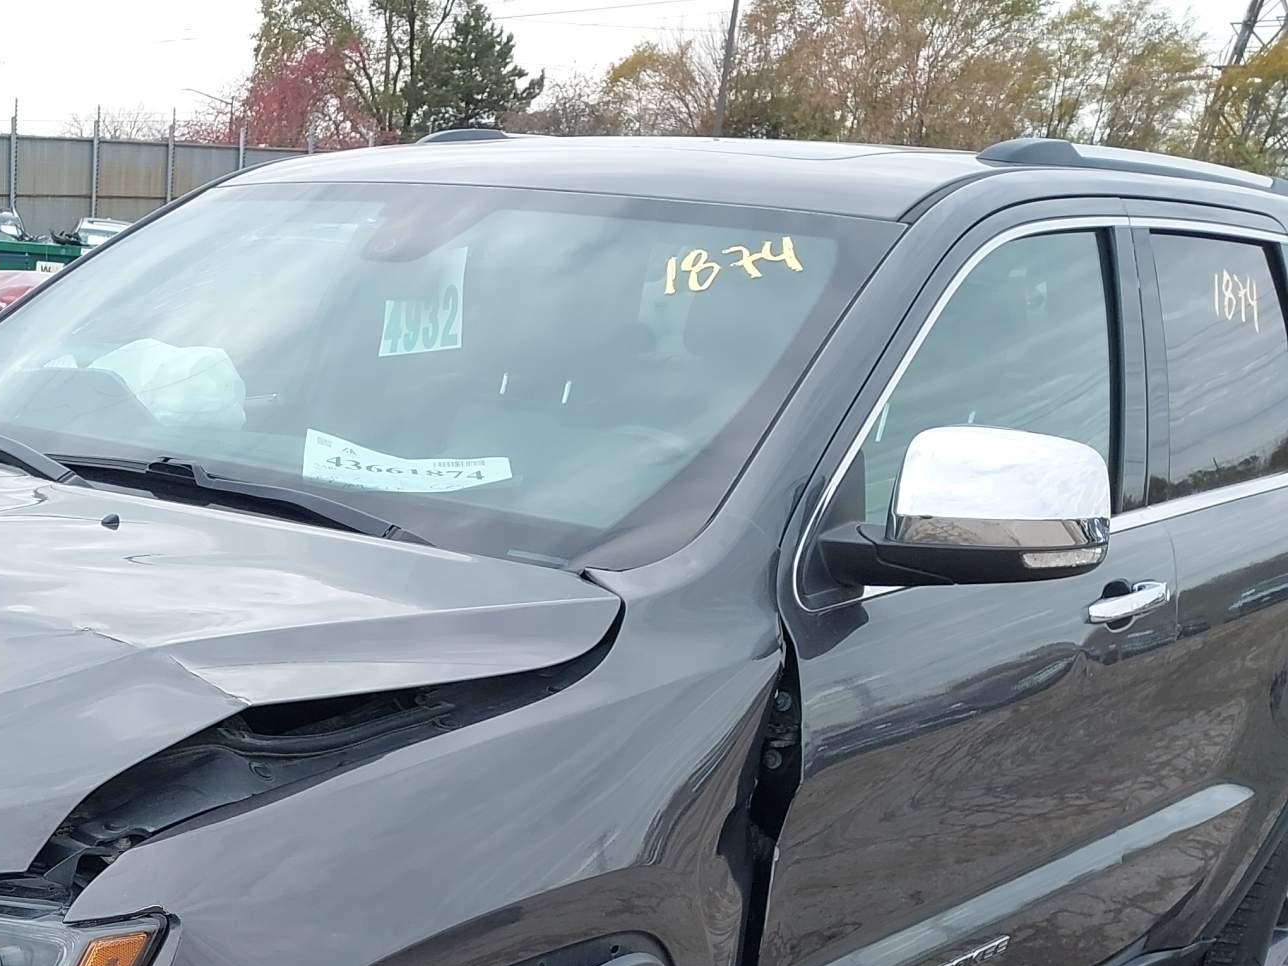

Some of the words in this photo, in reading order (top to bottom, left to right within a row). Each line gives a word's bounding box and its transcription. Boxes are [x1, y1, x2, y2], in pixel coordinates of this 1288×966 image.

[664, 235, 804, 296] 1874
[1214, 268, 1260, 334] 1874
[325, 455, 486, 481] 43661874
